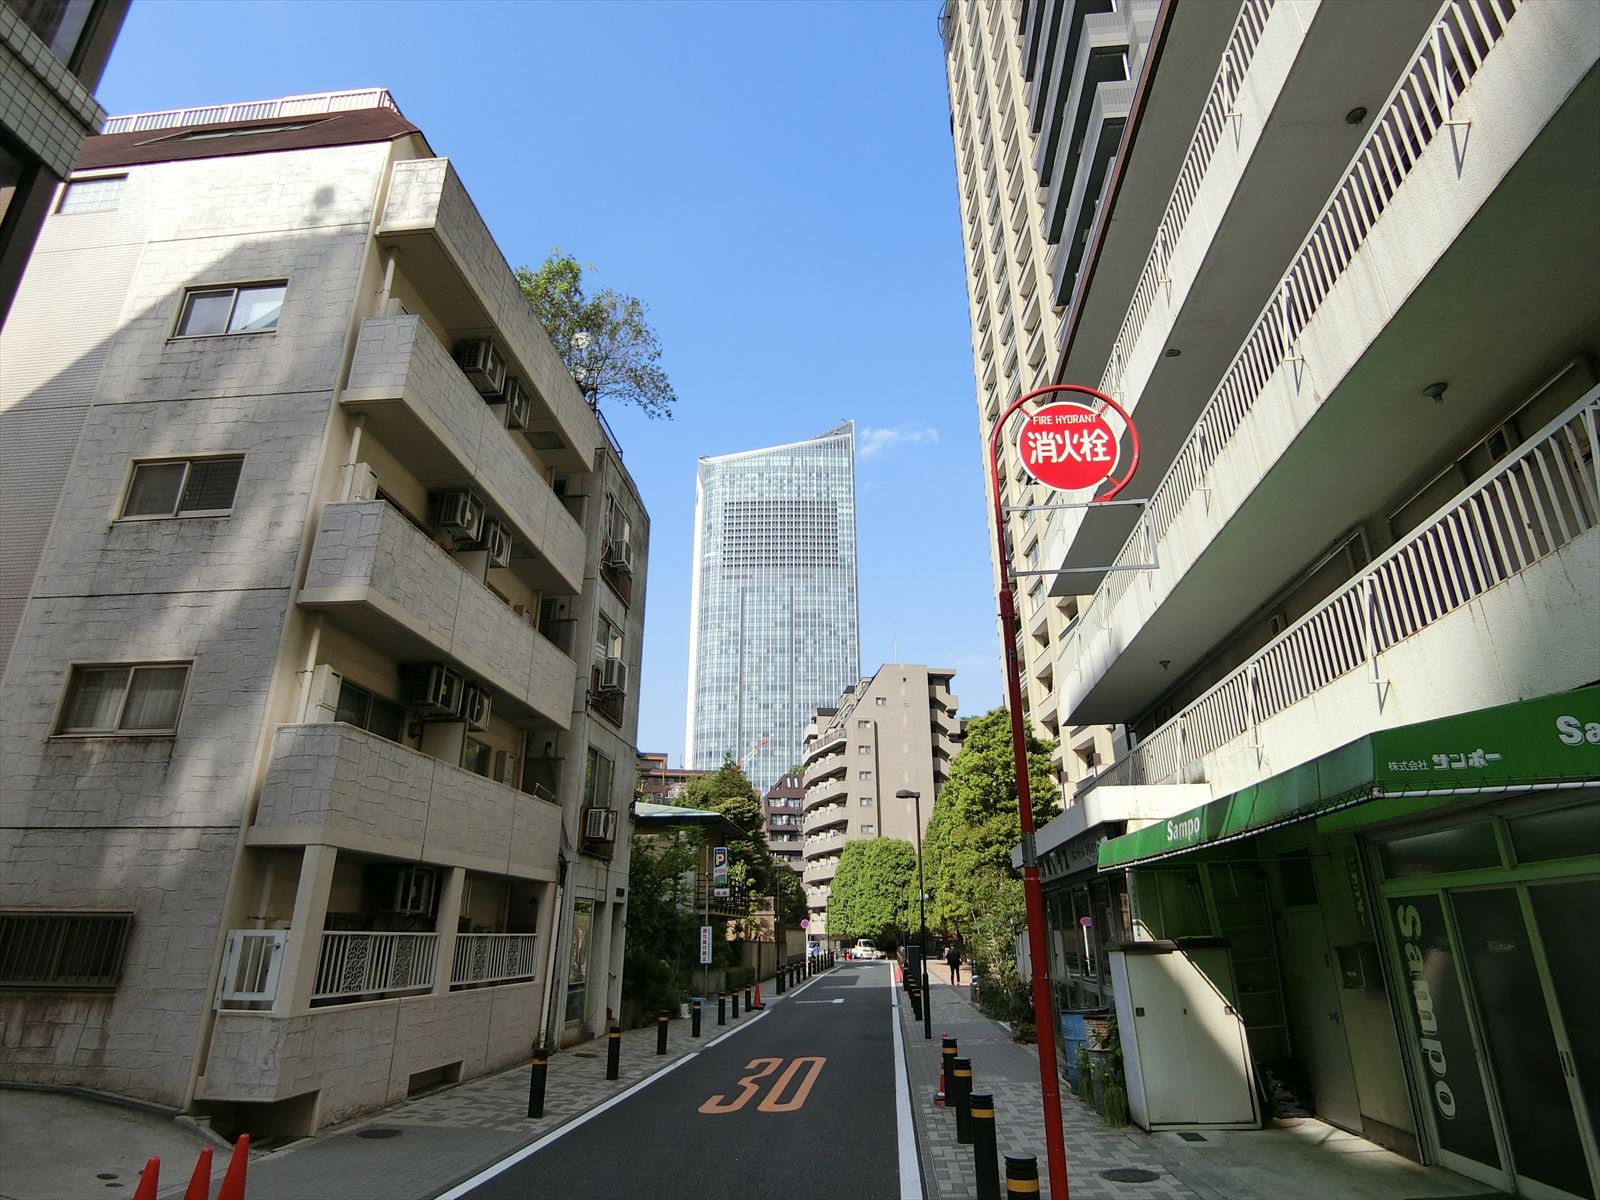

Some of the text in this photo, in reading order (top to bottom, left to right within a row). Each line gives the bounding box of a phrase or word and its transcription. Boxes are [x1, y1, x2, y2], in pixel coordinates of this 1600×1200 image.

[1032, 413, 1097, 425] FIRE HYDRANT
[1027, 428, 1111, 464] 消火栓
[1387, 748, 1502, 772] 株式会社 サンポー
[1167, 816, 1200, 842] Sampo
[715, 853, 725, 866] P
[1396, 904, 1456, 1120] Sampo
[697, 1056, 827, 1114] 30
